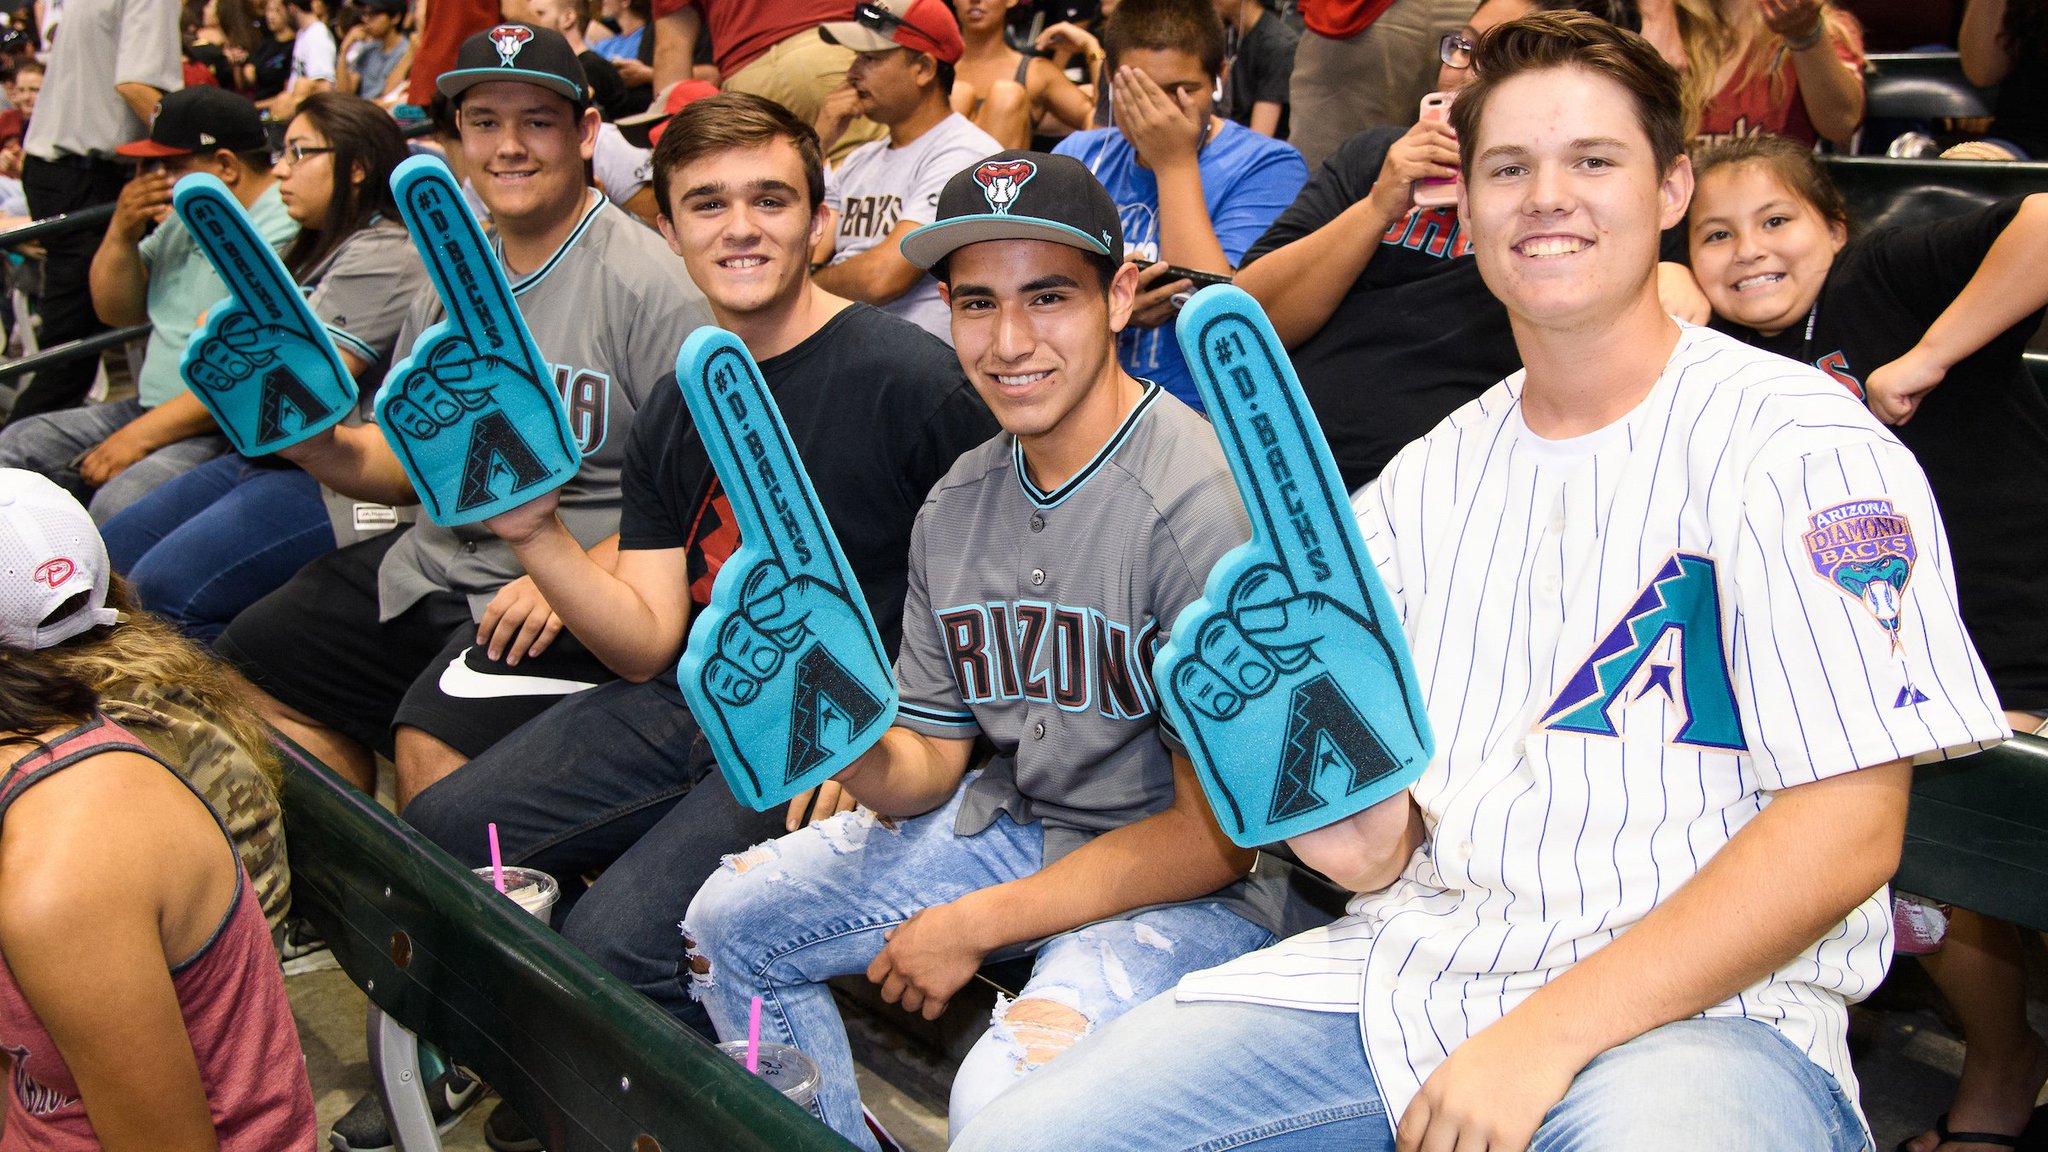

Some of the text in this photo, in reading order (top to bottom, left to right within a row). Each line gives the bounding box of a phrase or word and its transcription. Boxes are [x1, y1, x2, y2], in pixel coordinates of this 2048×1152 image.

[417, 187, 441, 211] #1
[1214, 331, 1247, 367] #1
[714, 362, 738, 395] #1
[1816, 501, 1891, 529] ARIZONA
[1813, 516, 1903, 551] DIAMOND
[1820, 538, 1908, 565] BACKS
